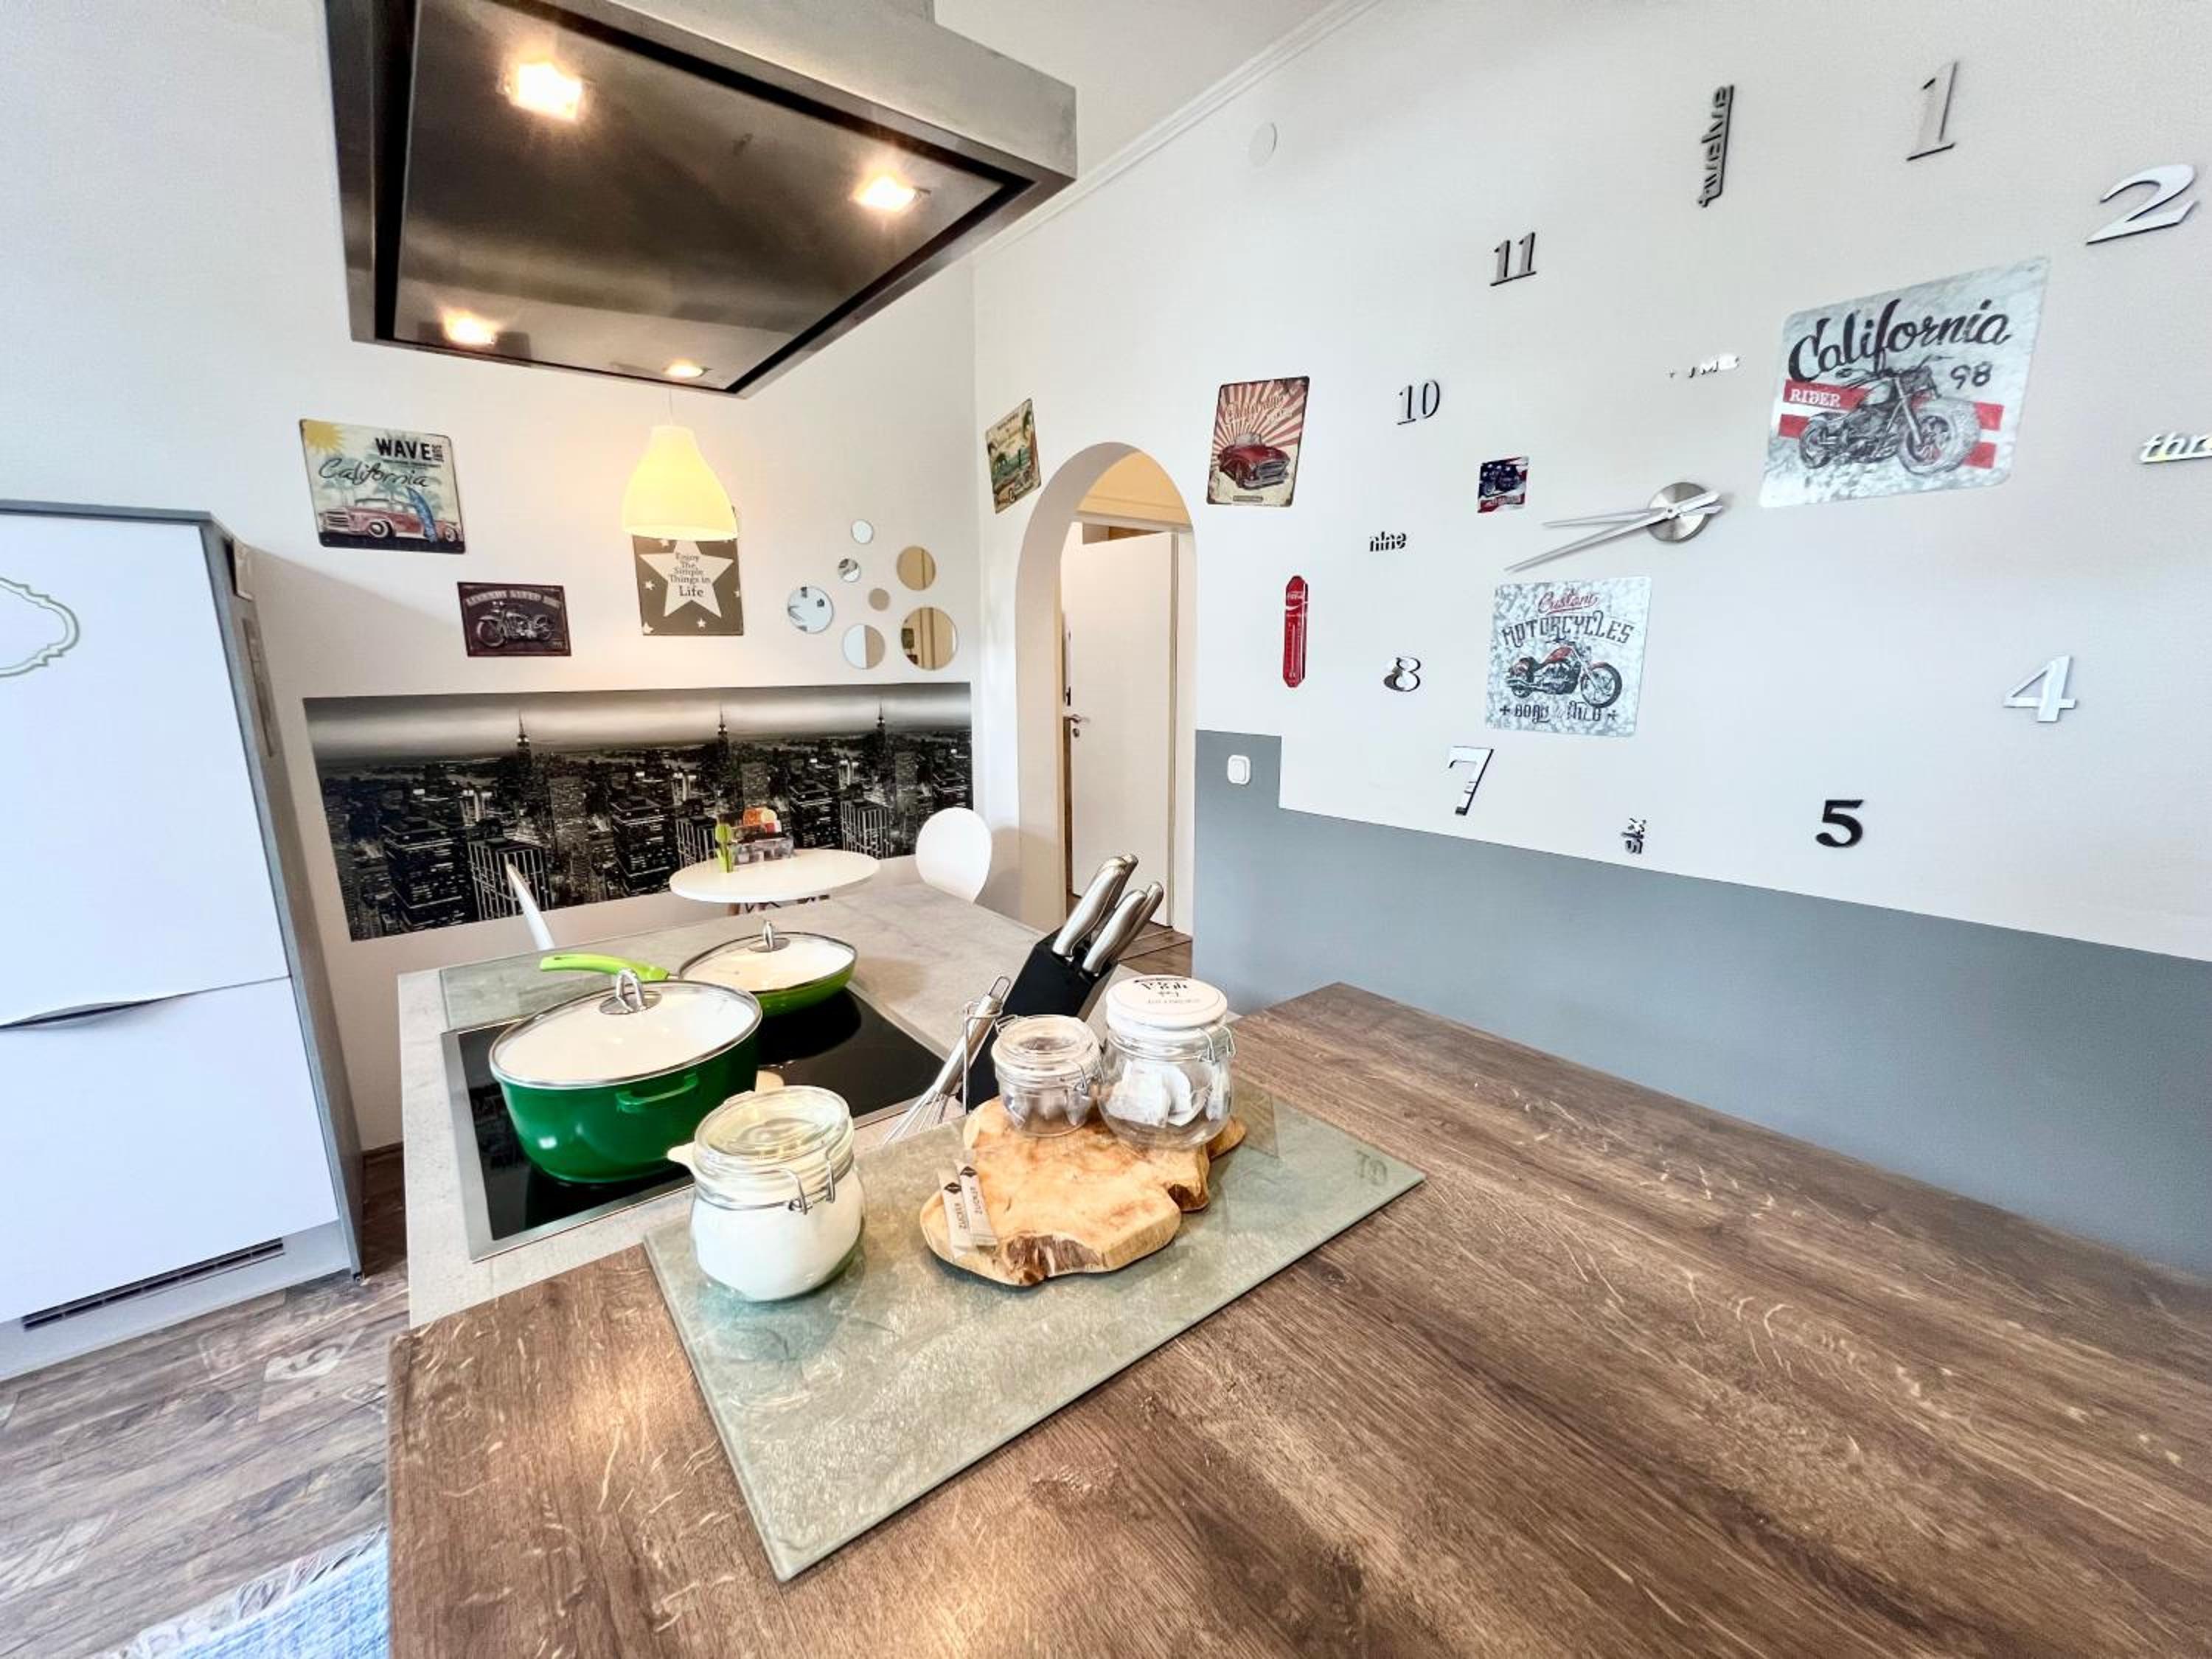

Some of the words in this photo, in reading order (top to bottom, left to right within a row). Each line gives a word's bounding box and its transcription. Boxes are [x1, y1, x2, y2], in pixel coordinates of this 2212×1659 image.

[1907, 61, 1958, 161] 1
[2085, 164, 2197, 245] 2
[1490, 232, 1537, 286] 11
[1788, 298, 2014, 383] California
[1950, 362, 1994, 391] 98
[1397, 379, 1441, 425] 10
[1788, 388, 1842, 408] RIDER
[375, 437, 431, 461] WAVE
[319, 458, 431, 487] California
[1369, 531, 1407, 552] nine
[669, 574, 700, 584] Things
[678, 585, 704, 597] Life
[1537, 588, 1600, 615] Custom
[1500, 611, 1635, 647] MOTORCYCLES
[1383, 657, 1422, 692] 8
[2003, 653, 2077, 723] 4
[1448, 745, 1495, 816] 7
[1815, 799, 1865, 848] 5
